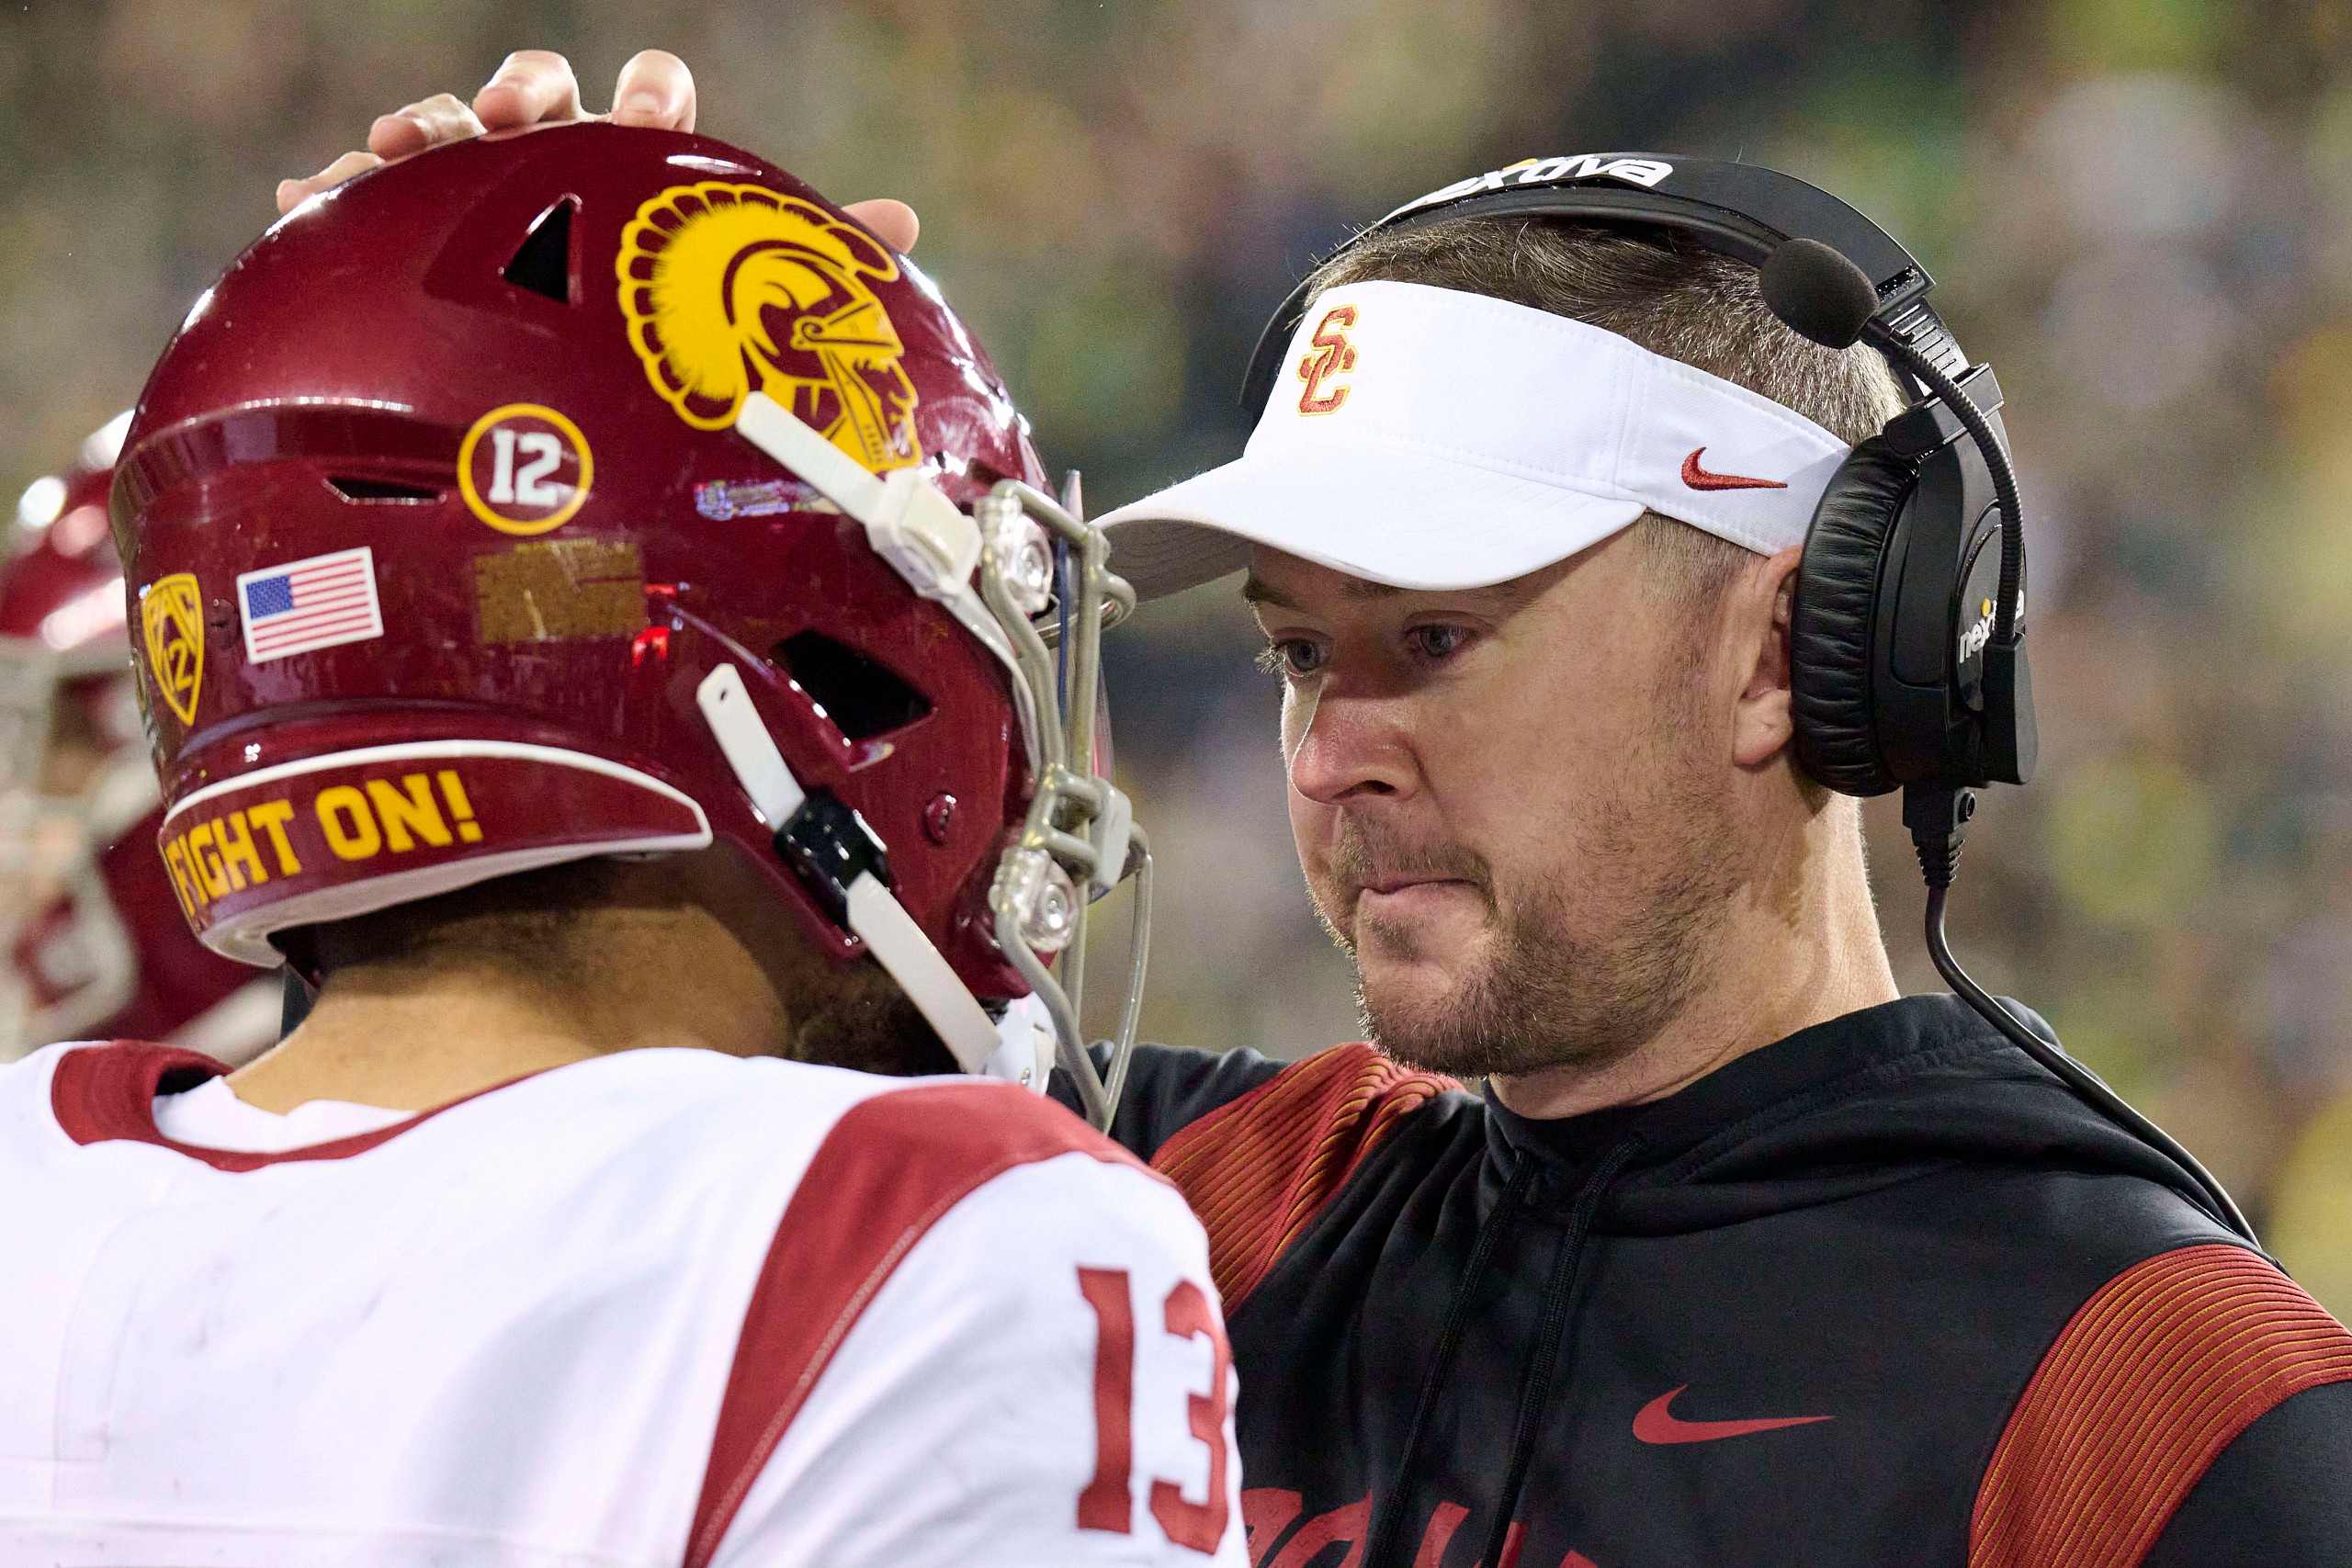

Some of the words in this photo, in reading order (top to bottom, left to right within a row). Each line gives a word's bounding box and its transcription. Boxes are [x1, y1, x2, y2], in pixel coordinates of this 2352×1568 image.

[1296, 304, 1359, 417] SC
[488, 428, 562, 506] 12
[164, 799, 302, 918] FIGHT
[314, 770, 483, 861] ON!
[1076, 1264, 1234, 1556] 13
